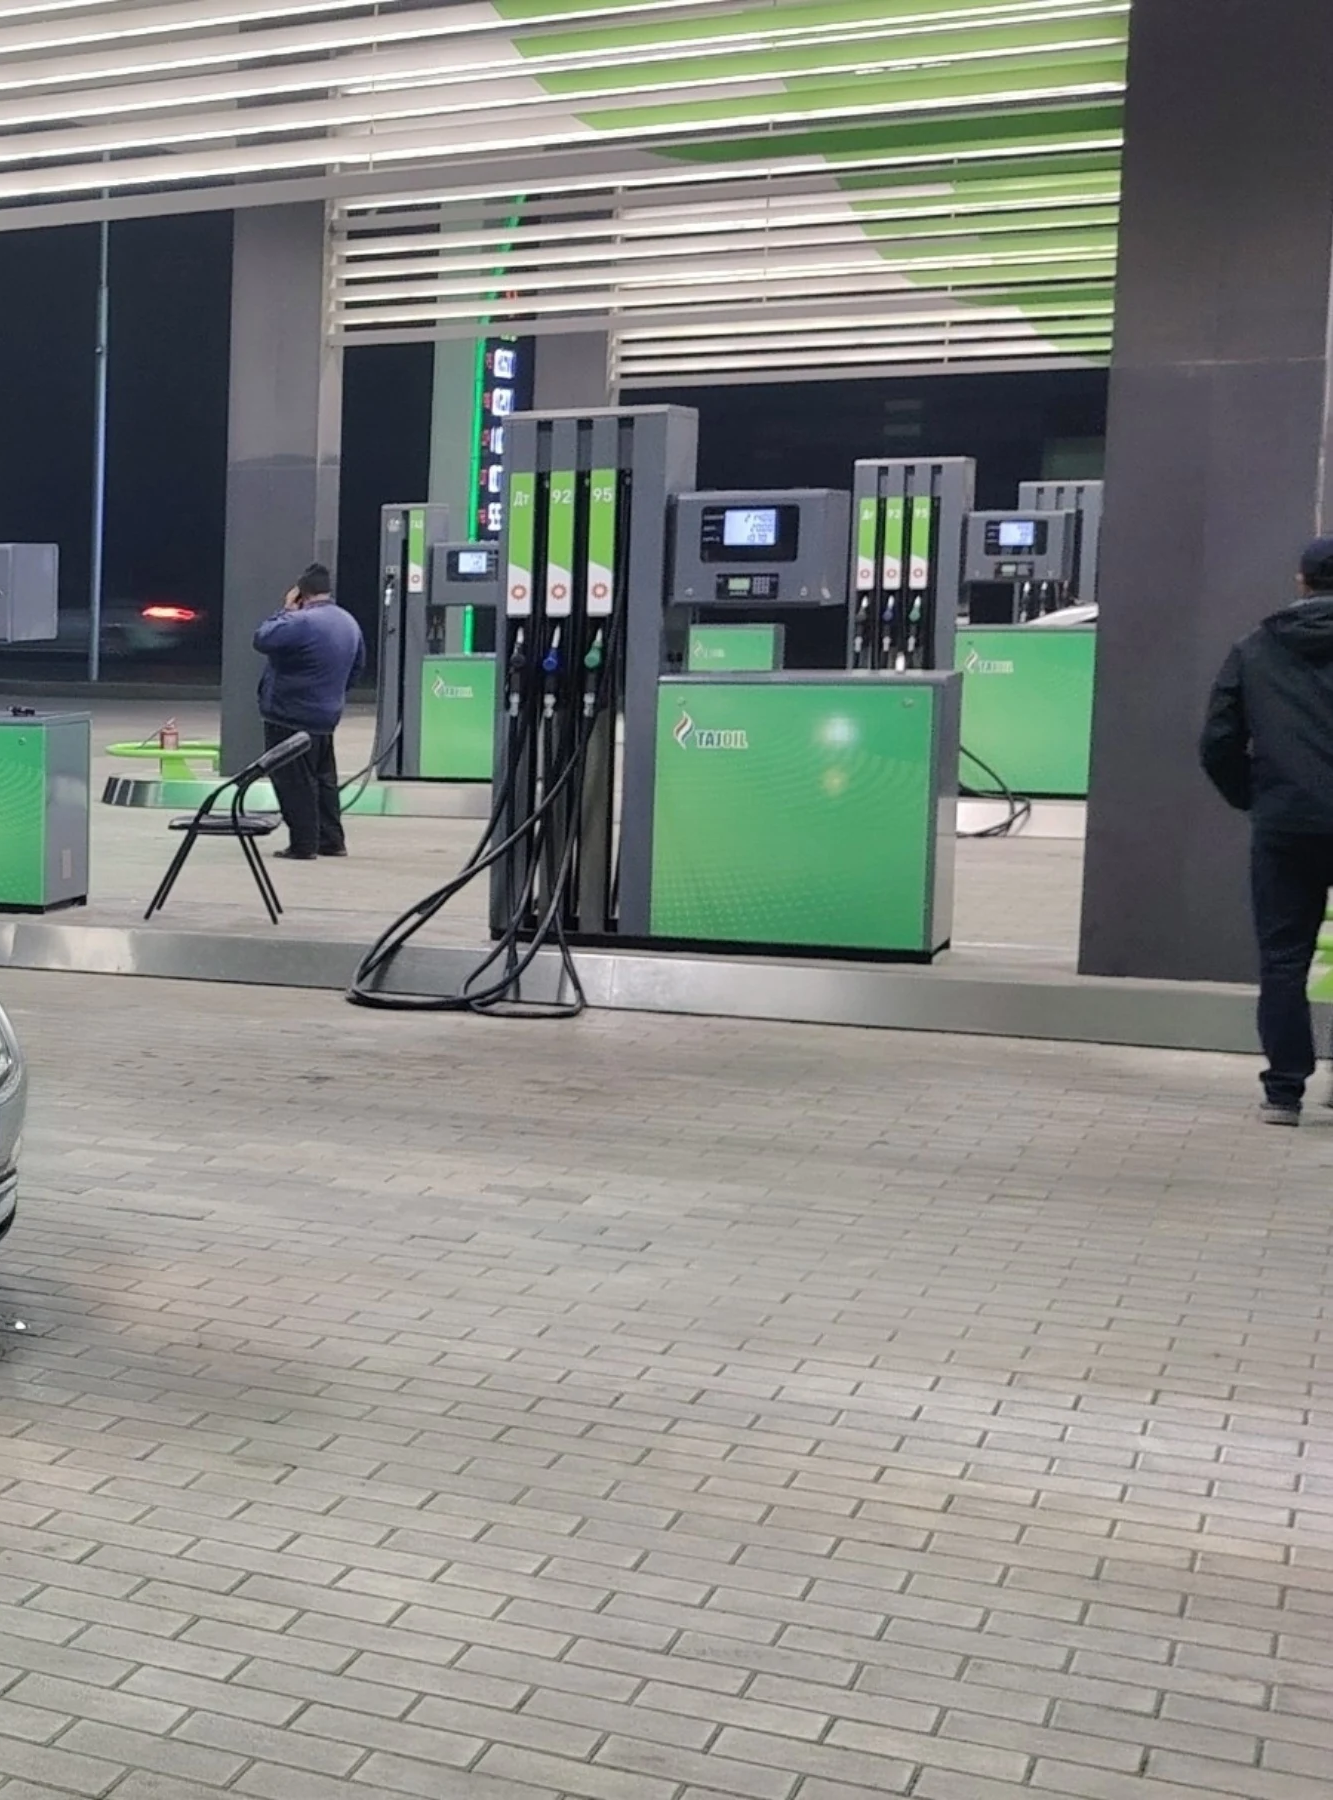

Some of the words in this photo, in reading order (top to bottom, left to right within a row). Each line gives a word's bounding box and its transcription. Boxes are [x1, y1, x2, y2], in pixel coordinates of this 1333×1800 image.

[552, 489, 572, 504] 92
[594, 488, 613, 503] 95
[695, 729, 748, 748] TAJOIL
